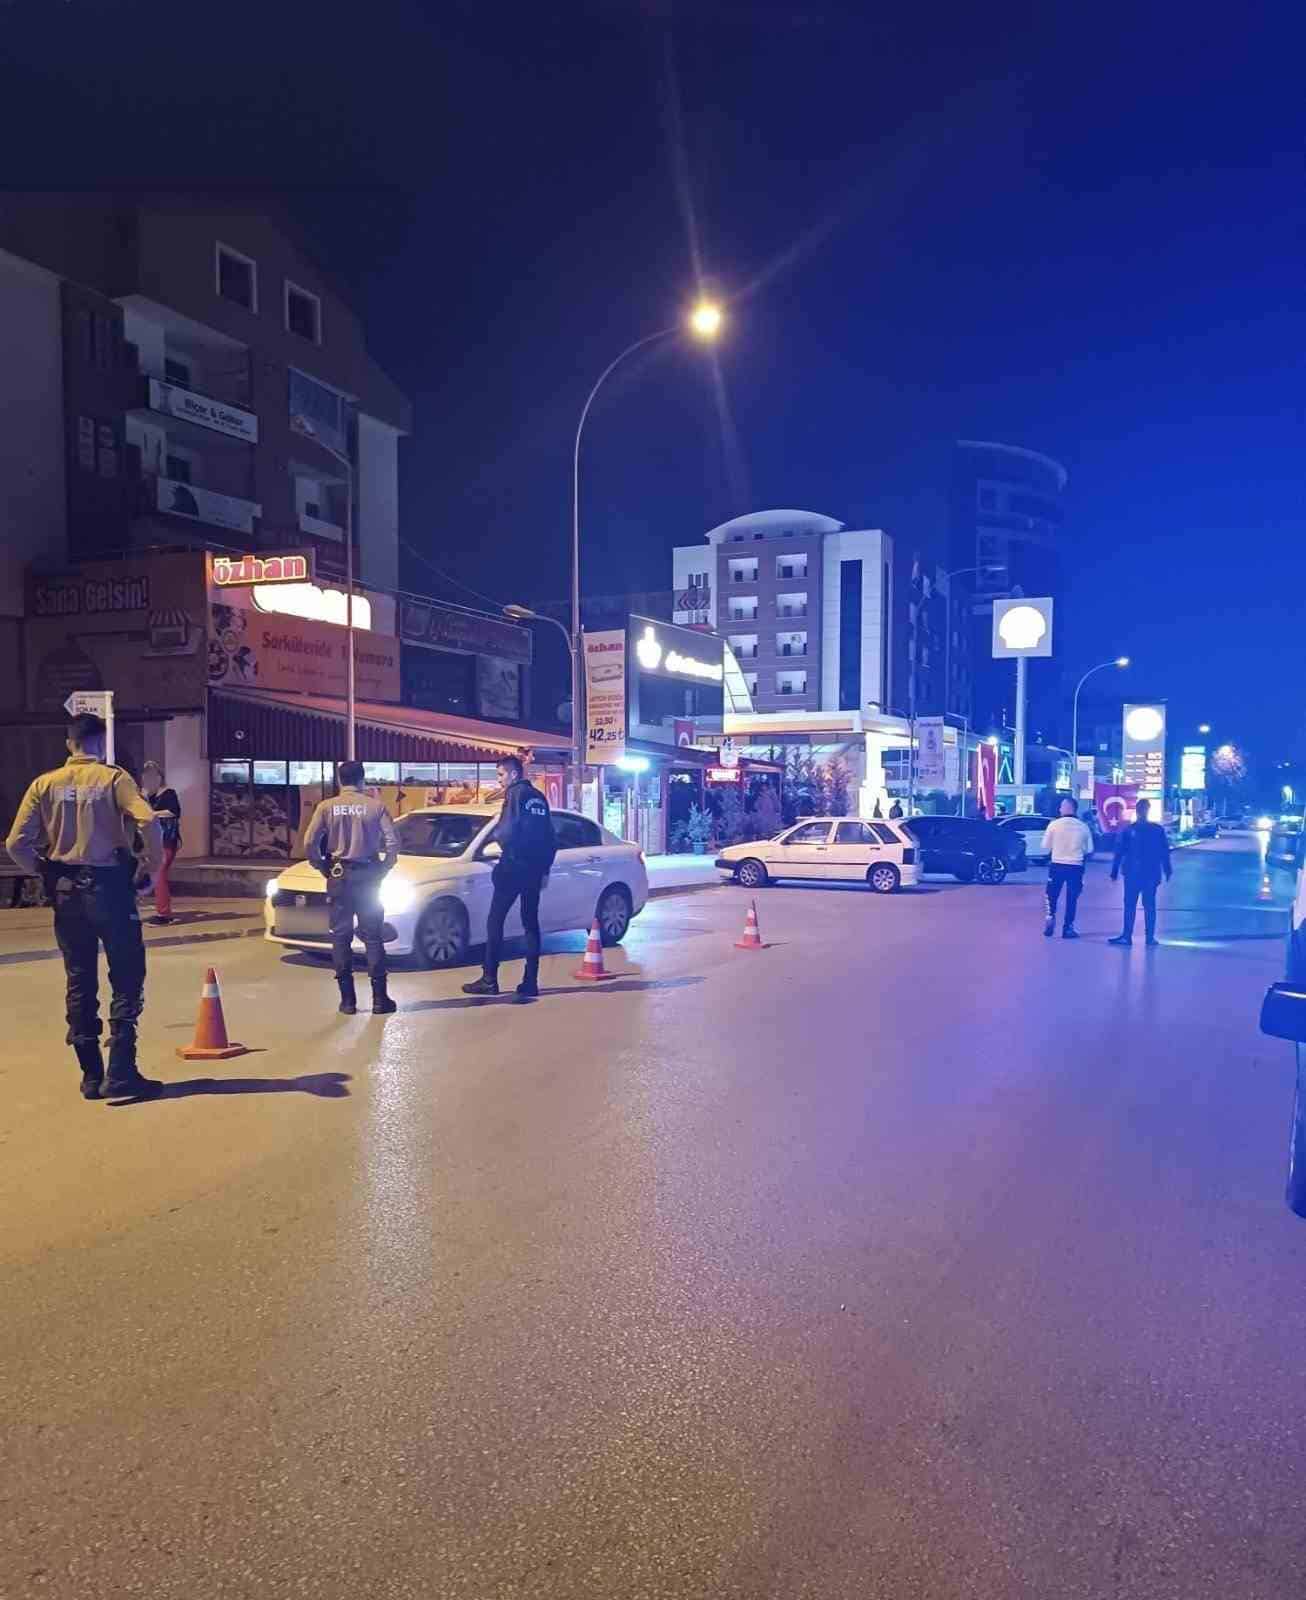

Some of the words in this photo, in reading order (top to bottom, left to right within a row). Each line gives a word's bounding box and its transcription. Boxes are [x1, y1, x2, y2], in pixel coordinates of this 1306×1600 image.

[213, 555, 306, 584] özhan
[34, 585, 80, 616] Sana
[84, 577, 149, 613] Gelsin!
